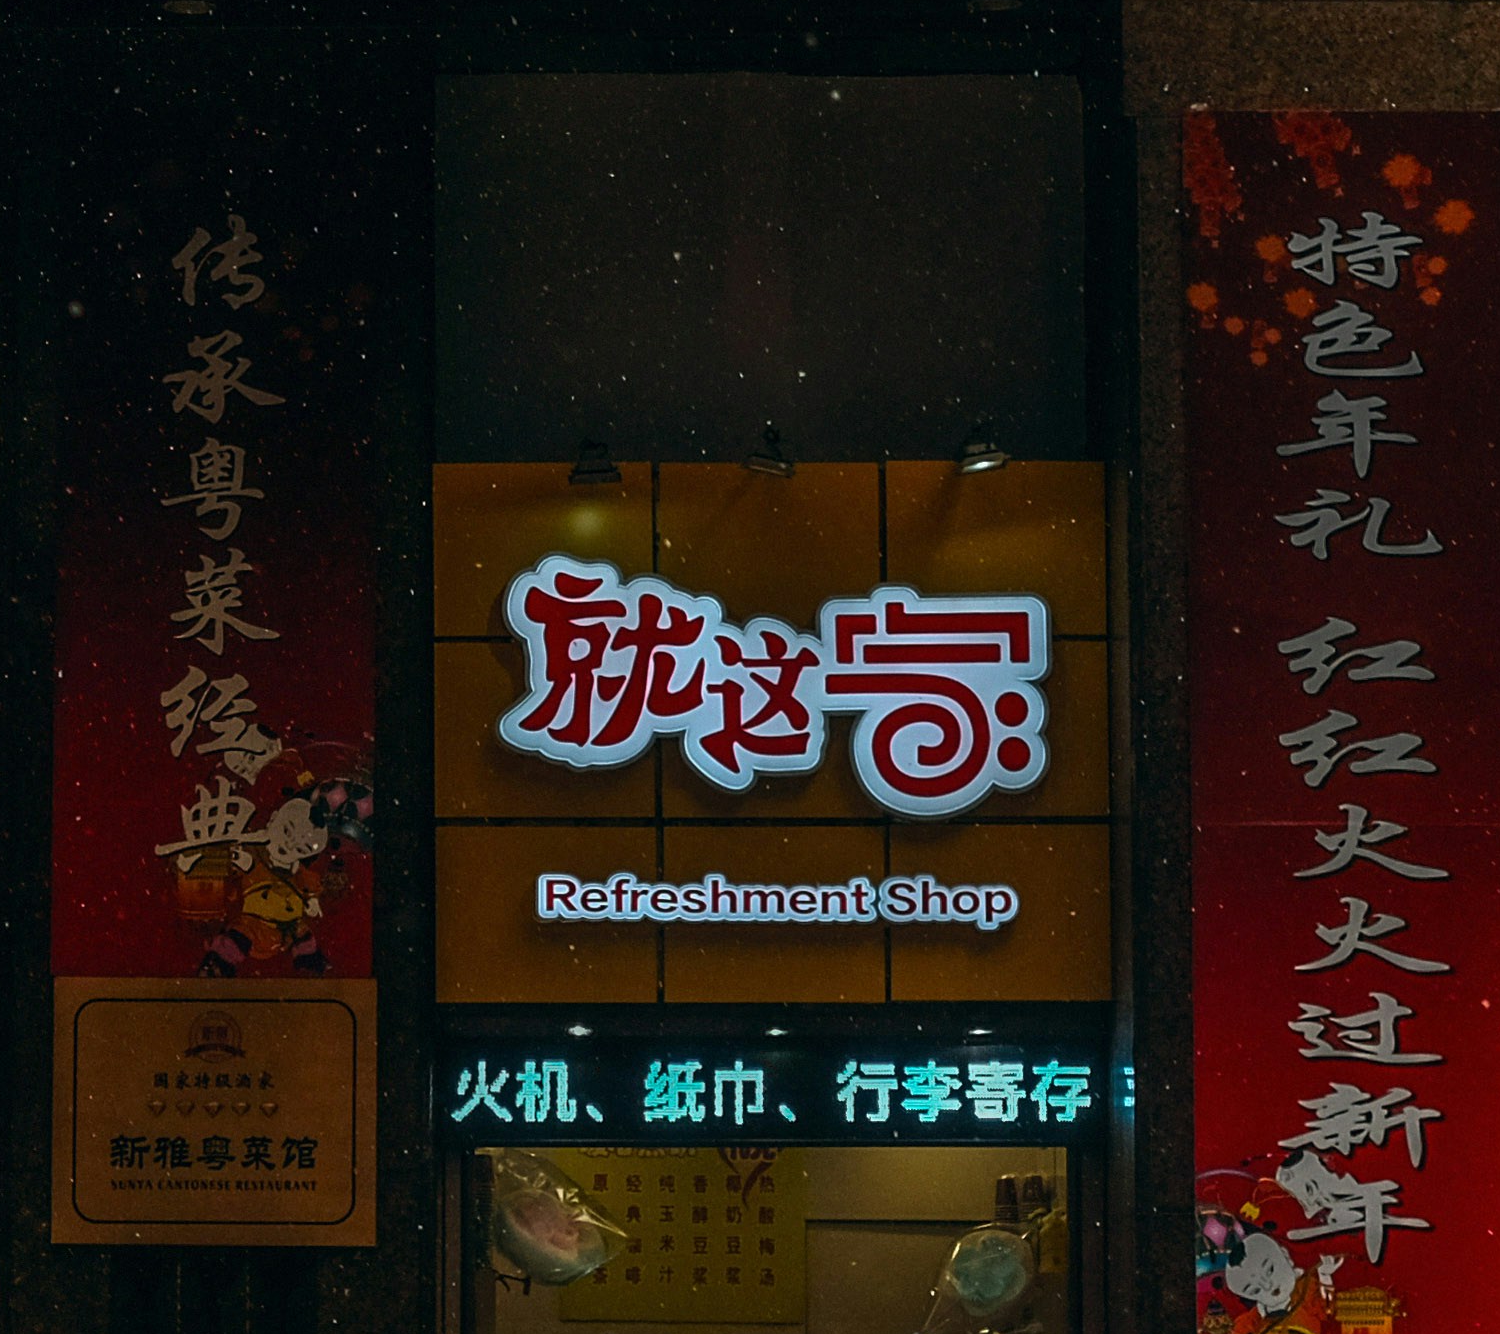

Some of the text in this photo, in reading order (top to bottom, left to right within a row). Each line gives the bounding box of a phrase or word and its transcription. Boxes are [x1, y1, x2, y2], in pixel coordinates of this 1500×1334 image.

[154, 214, 286, 874] 传承粤菜经典
[1274, 210, 1452, 1262] 特色年礼 红红火火过新年
[546, 879, 1013, 923] Refreshment Shop
[449, 1058, 1092, 1125] 火机、纸巾、行李寄存
[109, 1134, 319, 1169] 新雅粤菜馆
